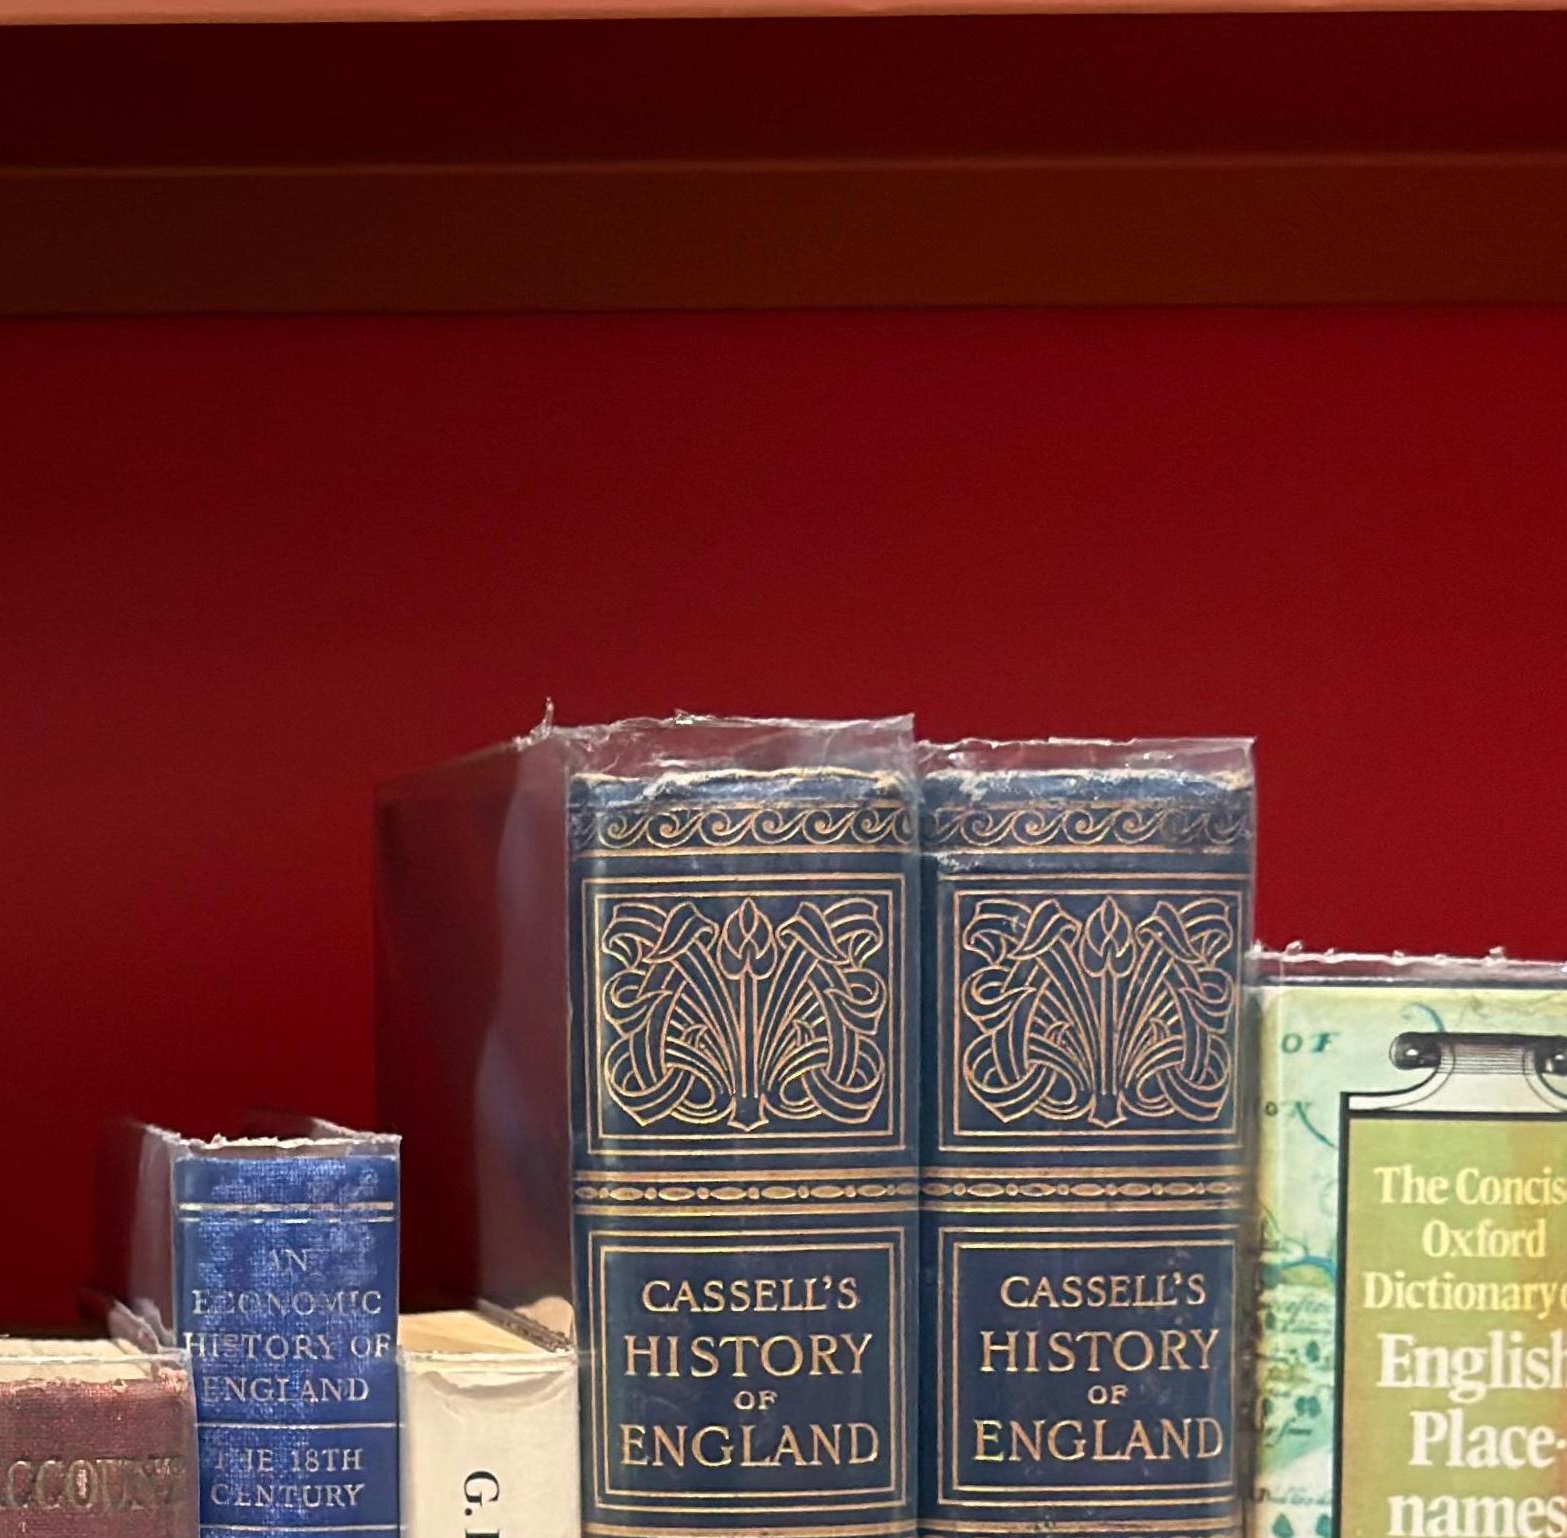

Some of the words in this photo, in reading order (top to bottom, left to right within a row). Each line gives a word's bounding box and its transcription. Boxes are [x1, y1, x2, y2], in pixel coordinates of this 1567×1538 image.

[1373, 1165, 1450, 1205] The
[1421, 1217, 1548, 1259] Oxford
[191, 1289, 382, 1316] ECONOMIC
[642, 1277, 859, 1313] CASSELL'S
[1000, 1272, 1206, 1308] CASSELL'S
[1362, 1270, 1561, 1320] Dictionary
[182, 1331, 336, 1360] HISTORY
[350, 1333, 392, 1360] OF
[624, 1334, 873, 1377] HISTORY
[980, 1329, 1220, 1373] HISTORY
[202, 1376, 370, 1402] ENGLAND
[733, 1389, 778, 1411] OF
[1088, 1384, 1129, 1405] OF
[620, 1423, 879, 1467] ENGLAND
[973, 1418, 1223, 1462] ENGLAND
[291, 1448, 364, 1472] 18TH
[210, 1483, 365, 1508] CENTURY
[464, 1470, 500, 1516] G.
